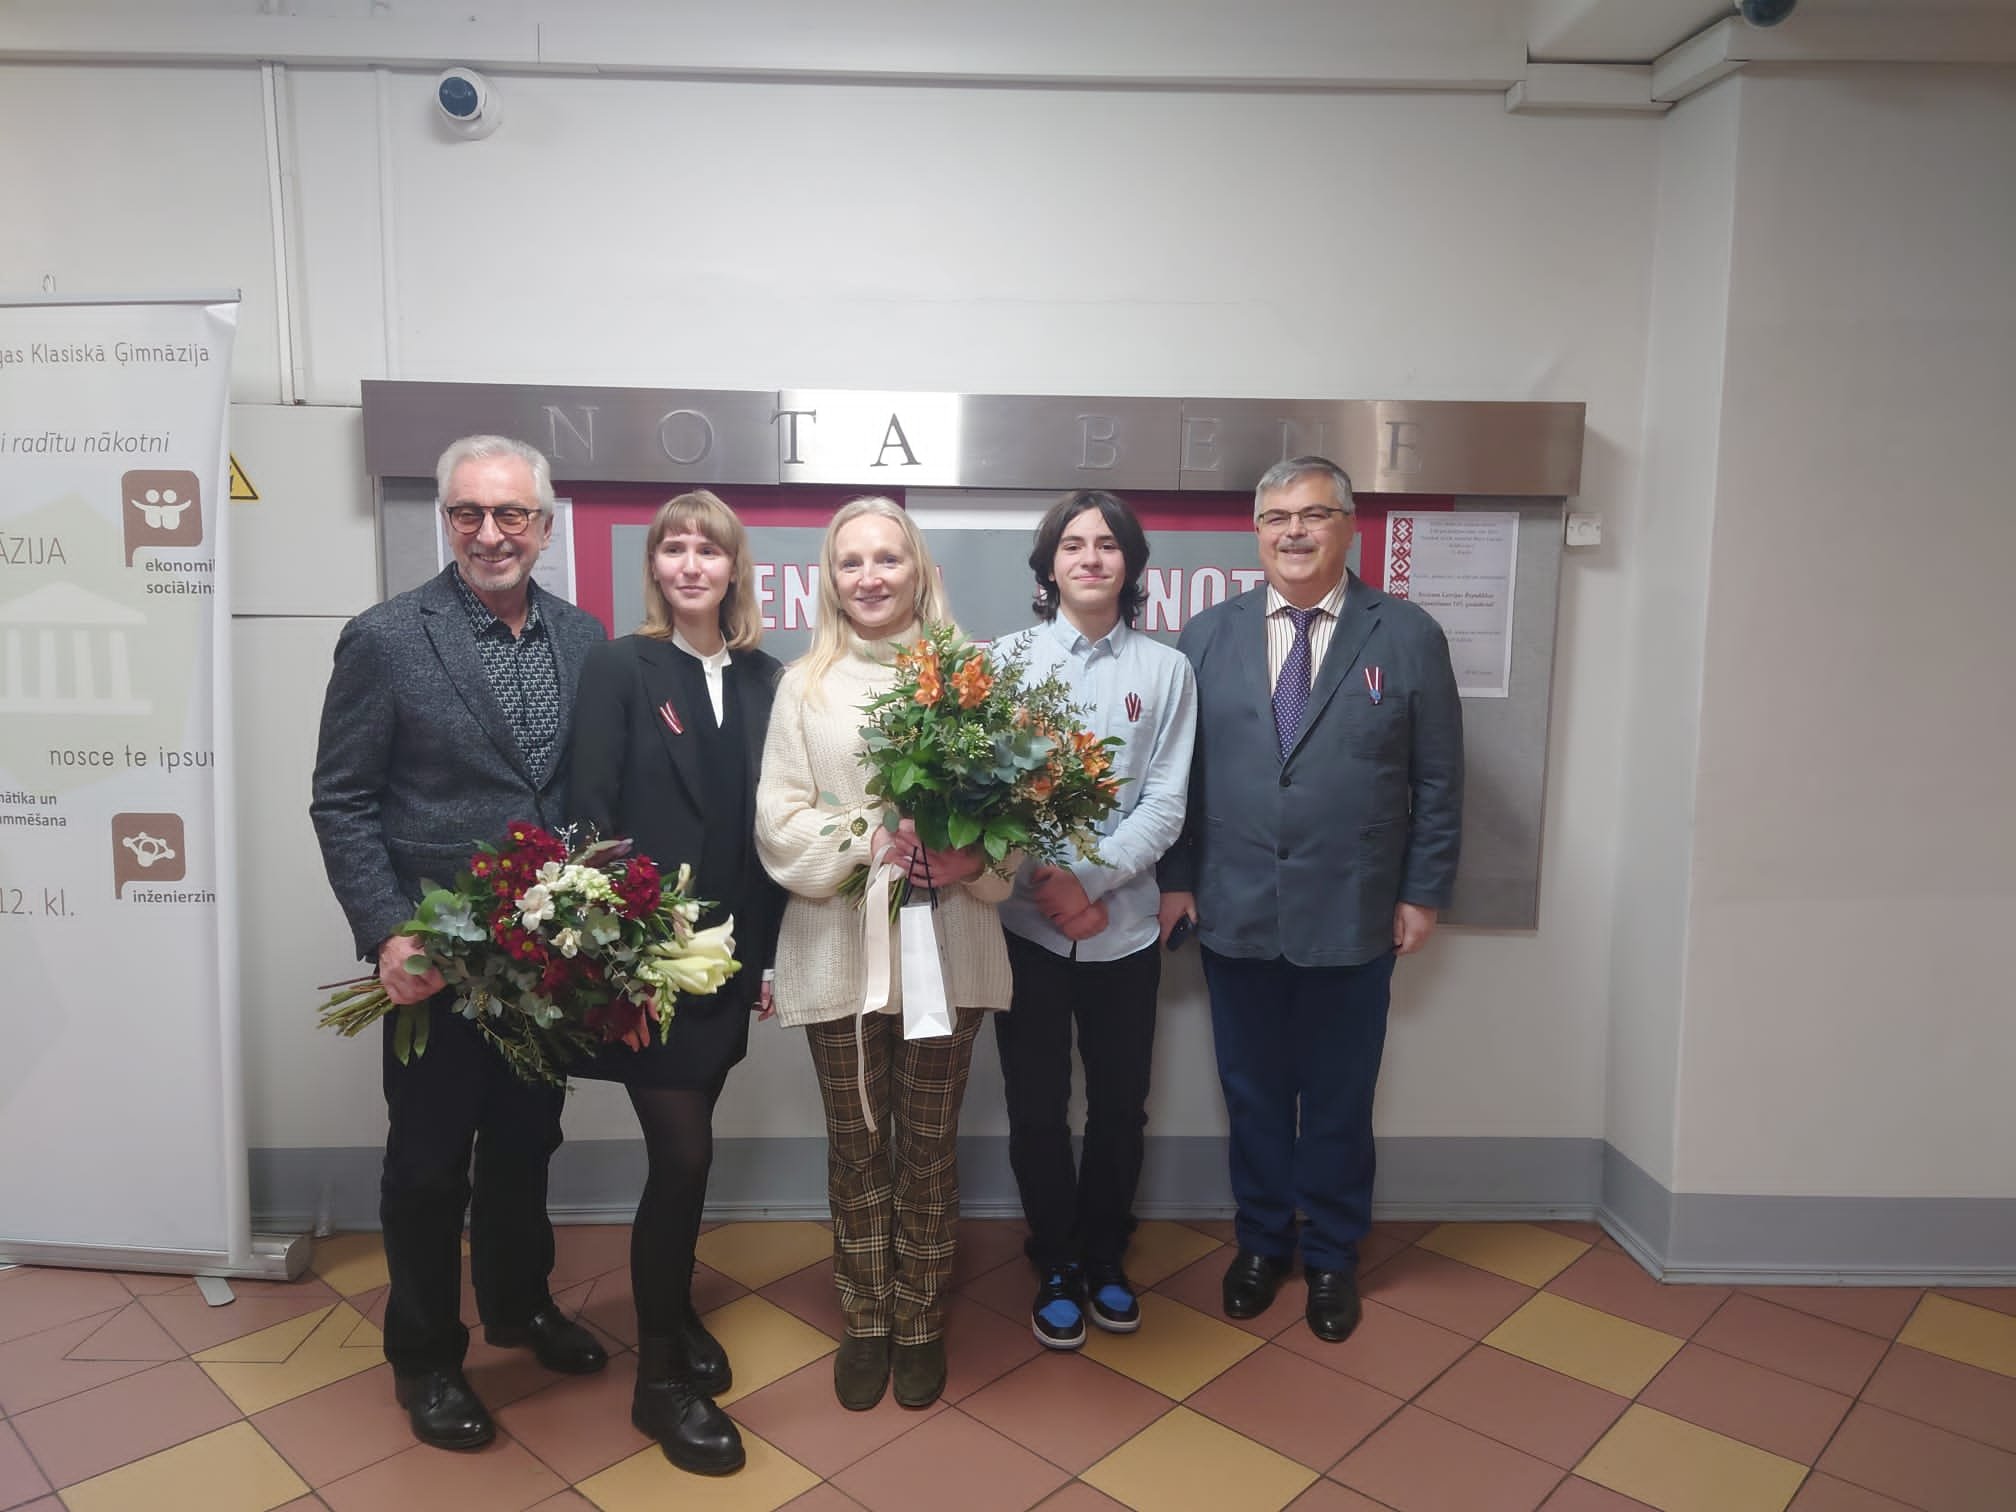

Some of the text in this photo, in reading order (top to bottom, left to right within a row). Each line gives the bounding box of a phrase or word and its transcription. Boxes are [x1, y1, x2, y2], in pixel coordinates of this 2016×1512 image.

[31, 343, 106, 364] Klasiskā
[115, 342, 209, 366] Ģimnāzija
[12, 431, 76, 453] radītu
[83, 432, 169, 453] nākotni
[543, 405, 922, 468] NOTA
[145, 558, 215, 573] ekonomi
[49, 744, 214, 774] nosce te ipsu
[40, 794, 57, 805] un
[44, 887, 75, 917] kl.
